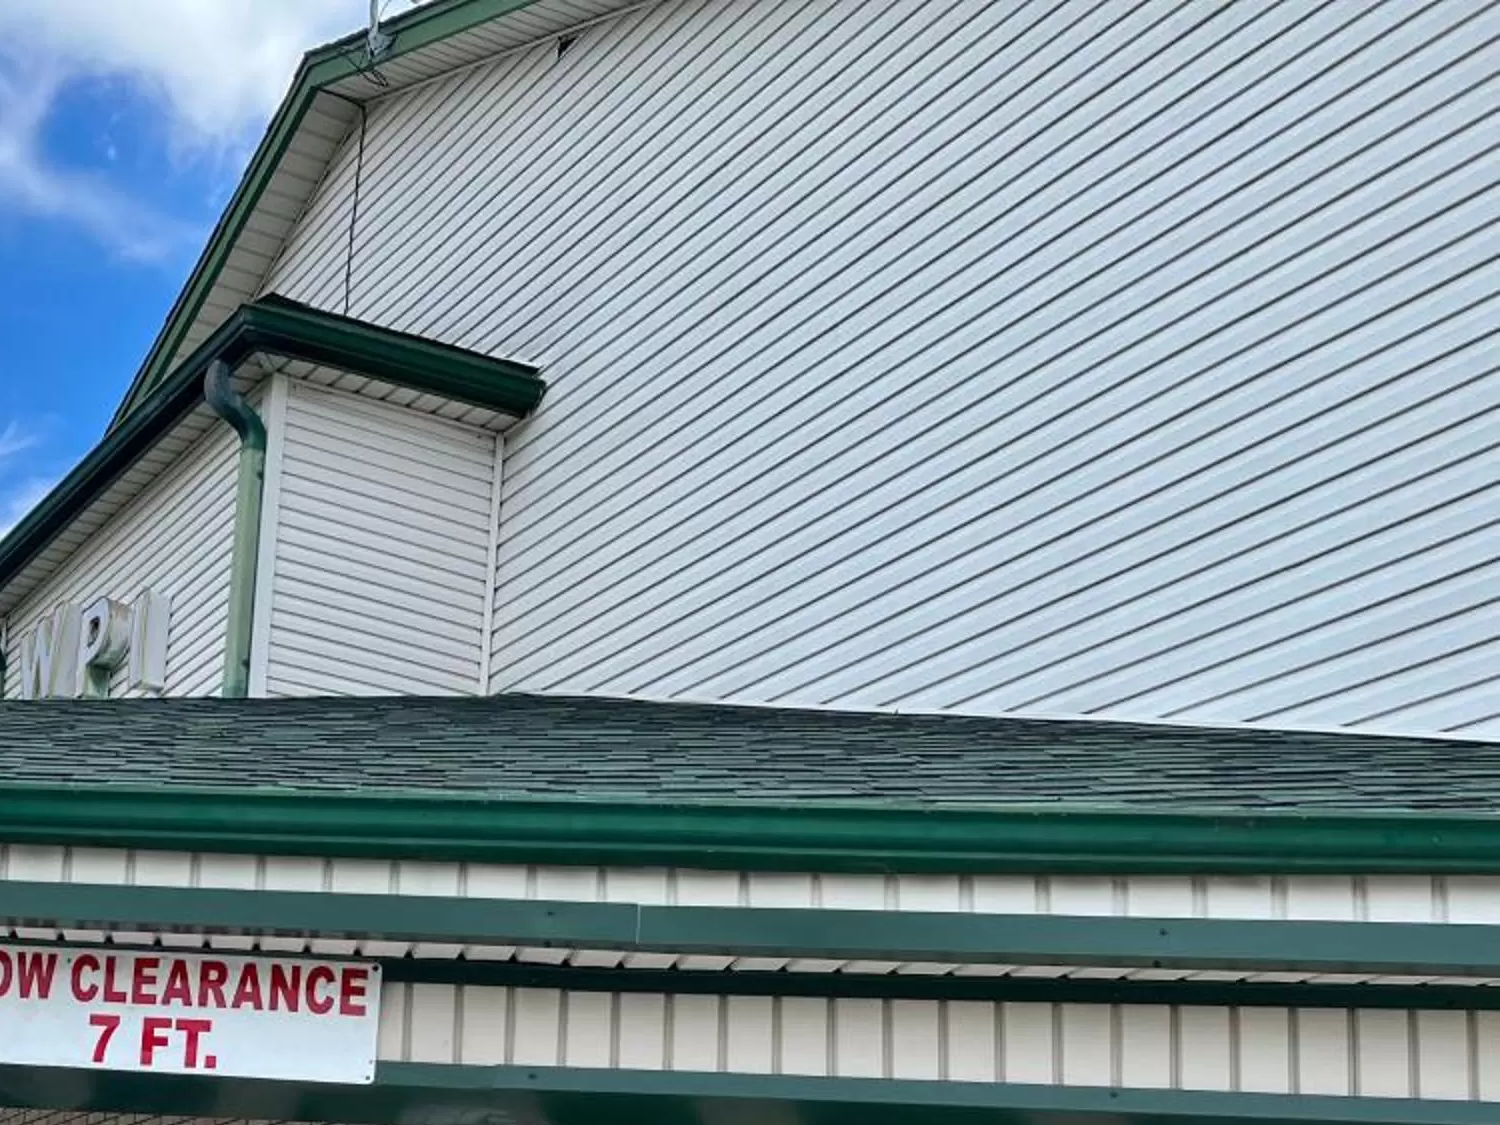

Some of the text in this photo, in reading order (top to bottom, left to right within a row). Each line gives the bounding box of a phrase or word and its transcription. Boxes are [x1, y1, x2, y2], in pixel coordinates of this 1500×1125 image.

[71, 953, 369, 1017] CLEARANCE
[89, 1014, 217, 1069] 7 FT.
